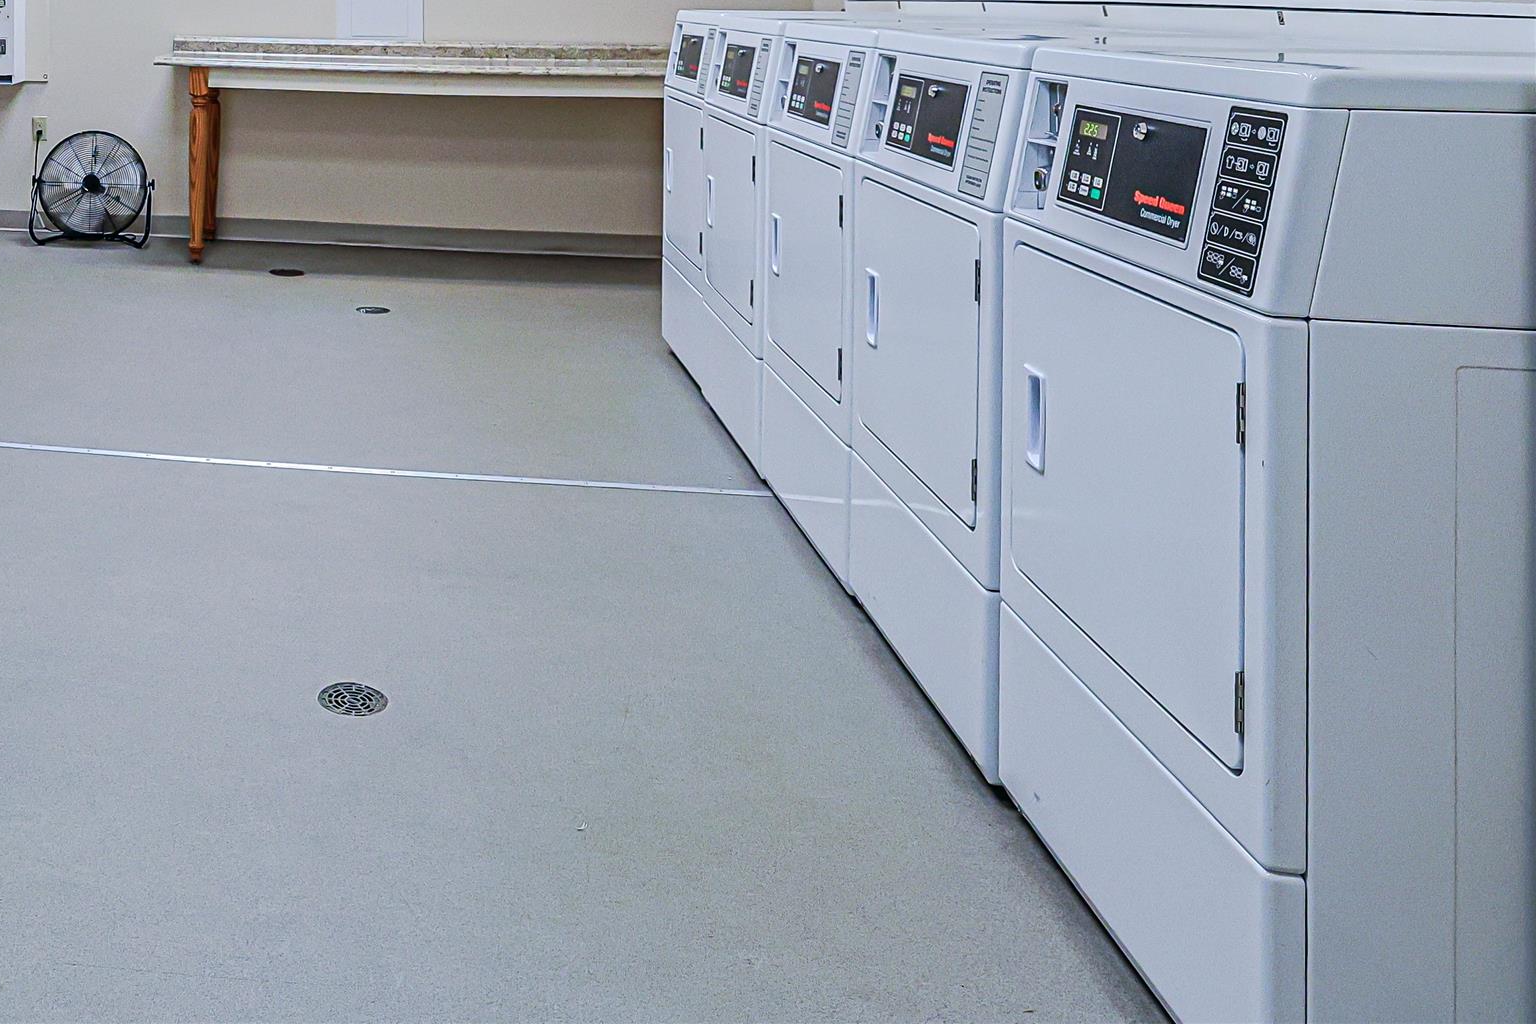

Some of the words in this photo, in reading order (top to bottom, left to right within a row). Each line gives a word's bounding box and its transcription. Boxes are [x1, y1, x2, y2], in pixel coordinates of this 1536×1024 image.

[1134, 190, 1159, 207] Speed
[1159, 197, 1184, 216] Queen
[1140, 208, 1167, 224] Commercial
[1167, 216, 1180, 229] Dryer
